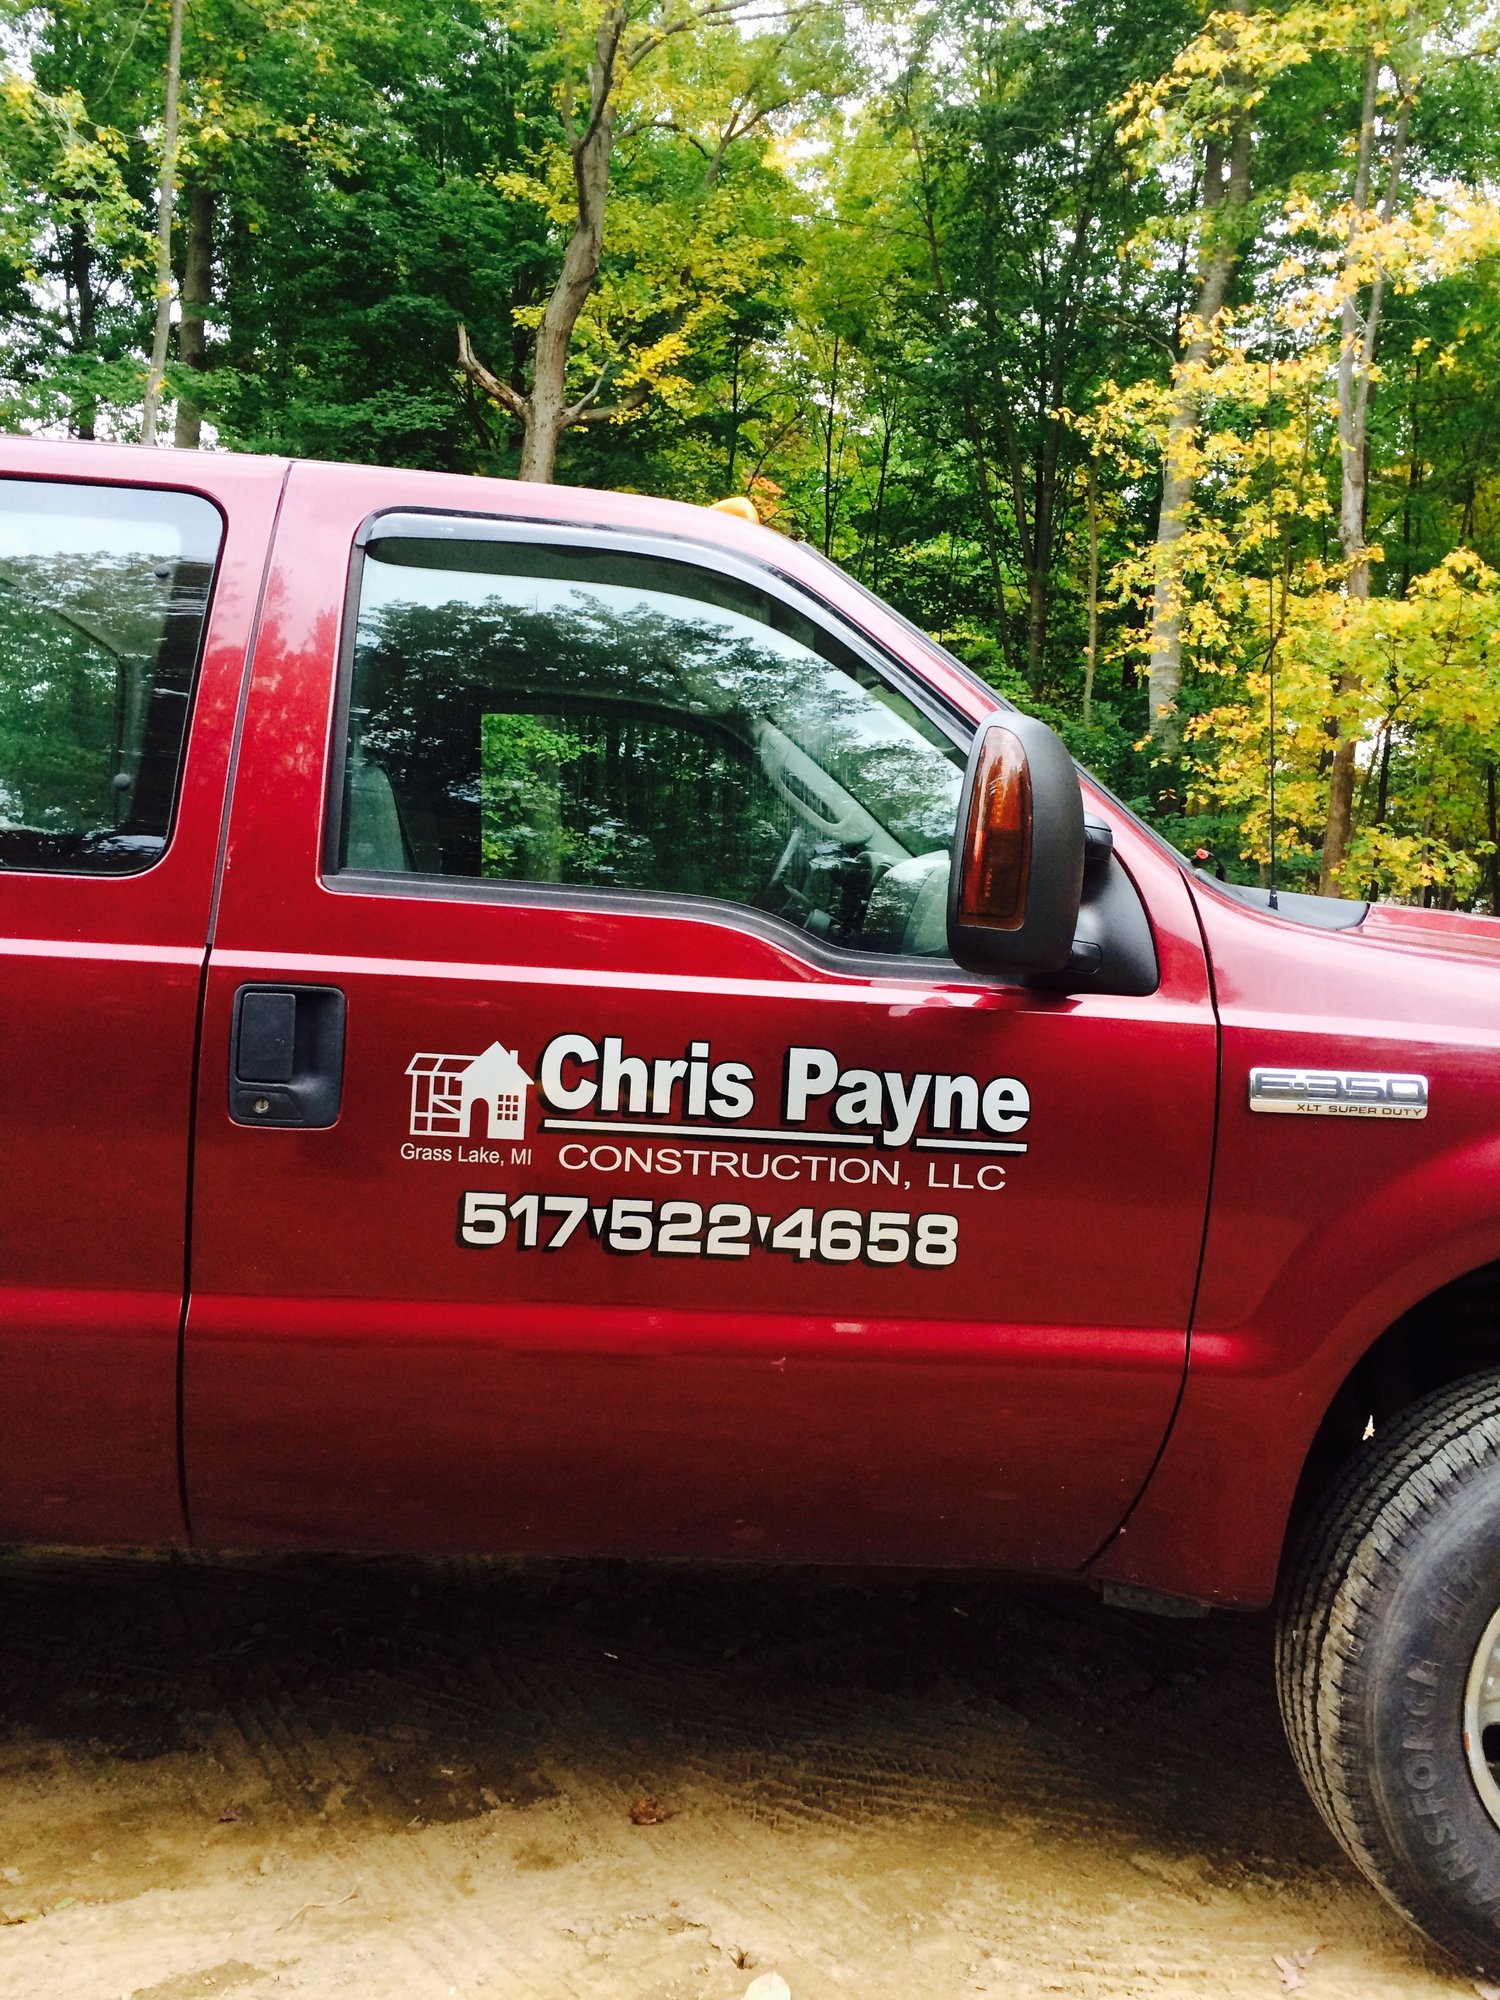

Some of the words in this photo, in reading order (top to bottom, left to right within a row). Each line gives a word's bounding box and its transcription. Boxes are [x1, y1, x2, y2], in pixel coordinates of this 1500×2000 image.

[541, 1034, 754, 1121] Chris
[786, 1046, 1031, 1147] Payne
[1254, 1072, 1427, 1104] F-350
[1296, 1103, 1322, 1113] XLT
[1328, 1105, 1378, 1115] SUPER
[1381, 1107, 1423, 1117] DUTY
[400, 1142, 453, 1162] Grass
[457, 1145, 504, 1168] Lake,
[510, 1147, 532, 1166] MI
[558, 1143, 911, 1191] CONSTRUCTION,
[928, 1162, 1006, 1191] LLC
